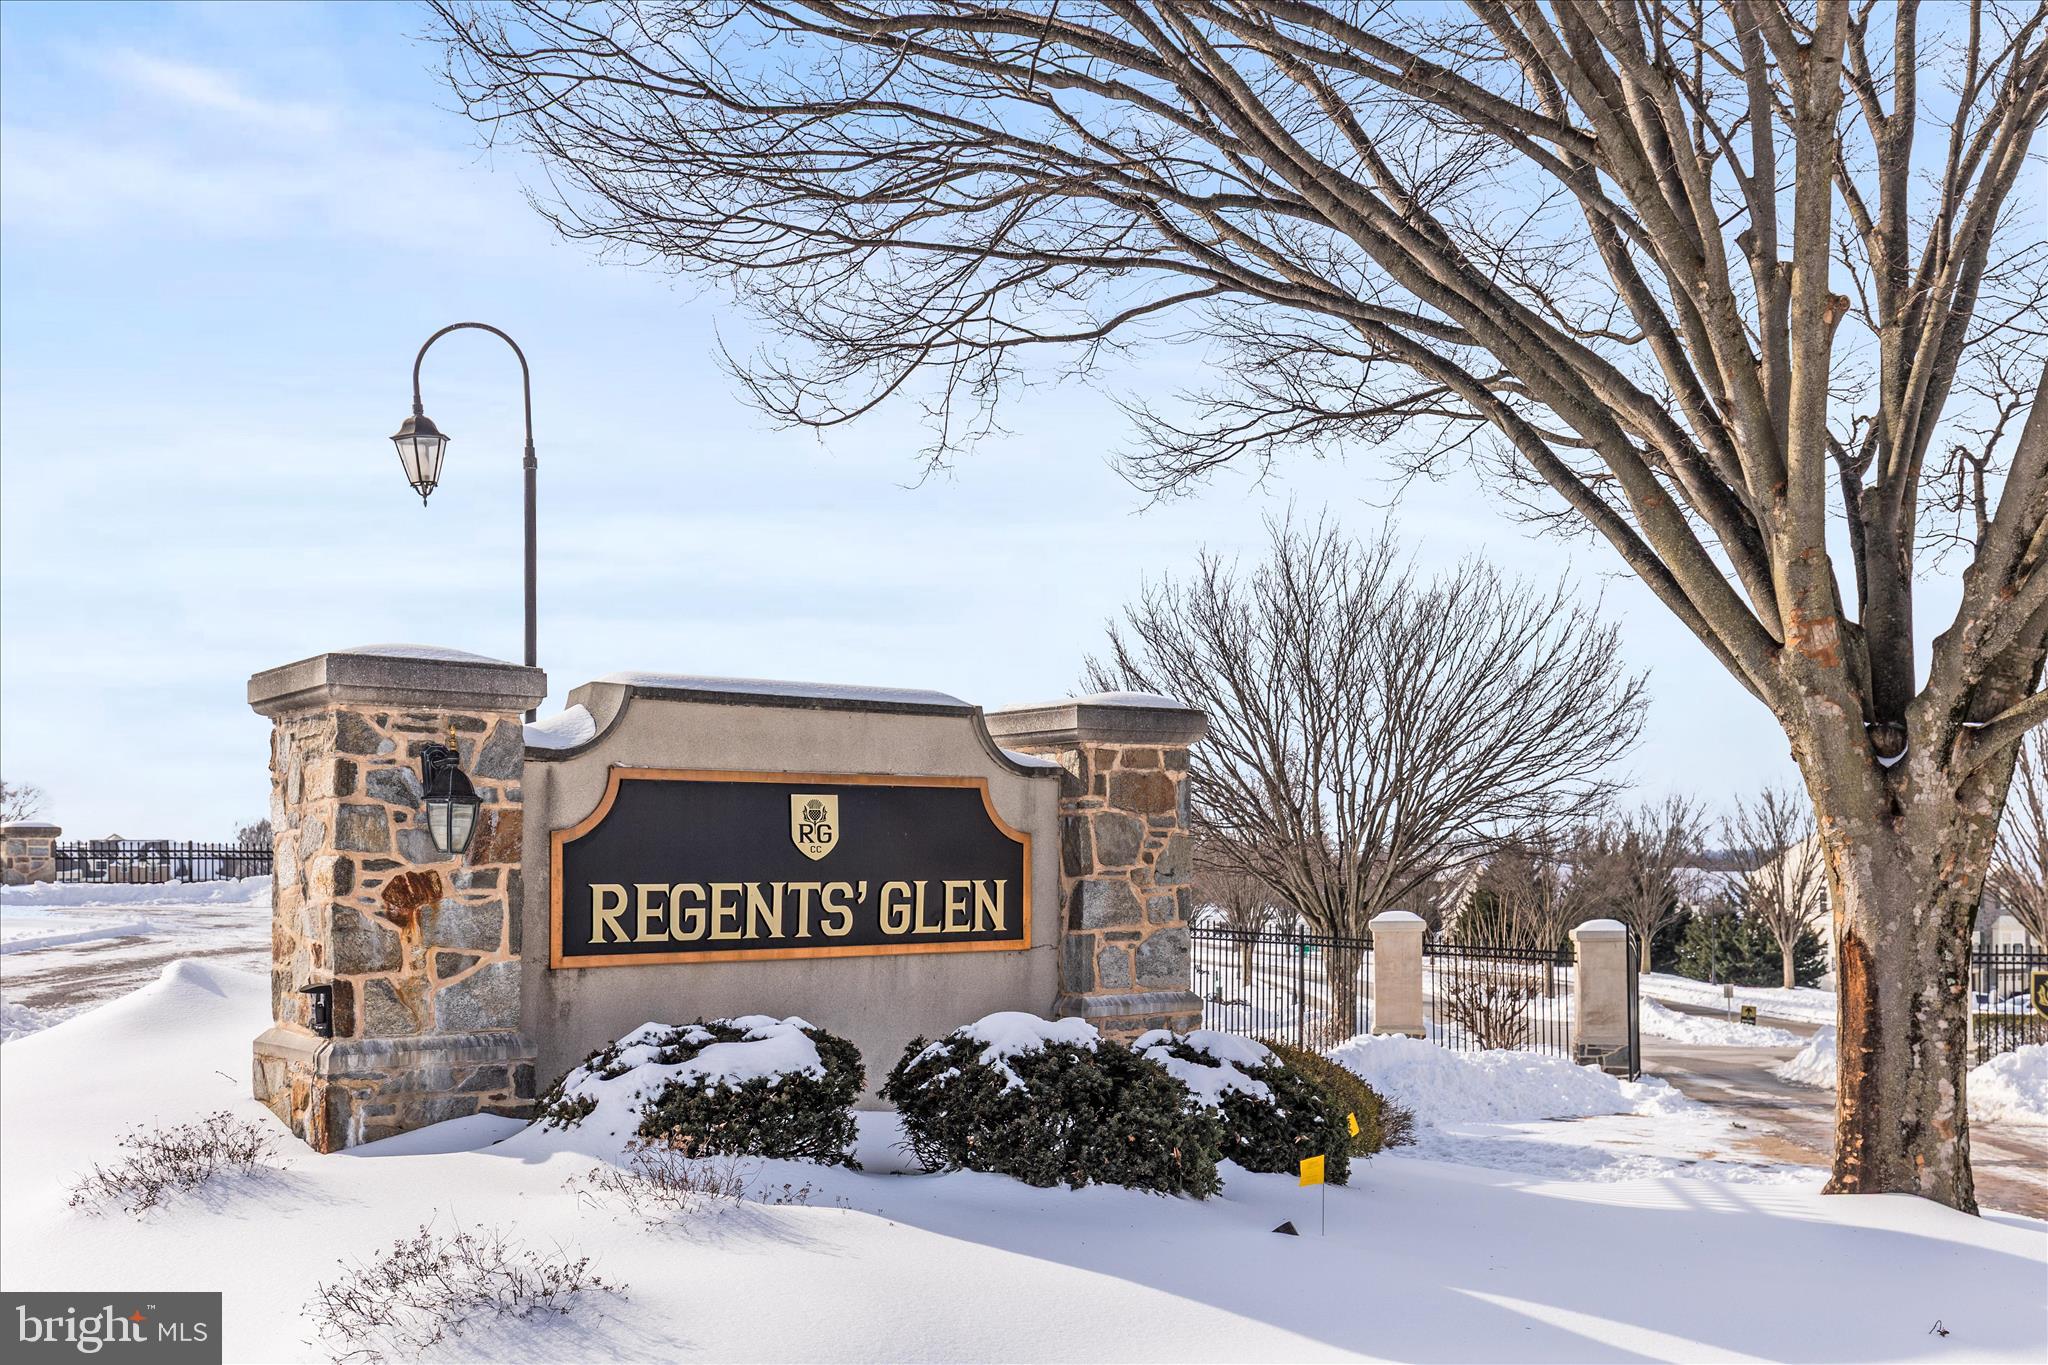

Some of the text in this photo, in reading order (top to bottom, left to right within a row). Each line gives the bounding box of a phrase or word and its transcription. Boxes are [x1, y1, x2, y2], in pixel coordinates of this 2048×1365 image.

[799, 823, 832, 844] RG
[587, 879, 1008, 943] REGENTS' GLEN
